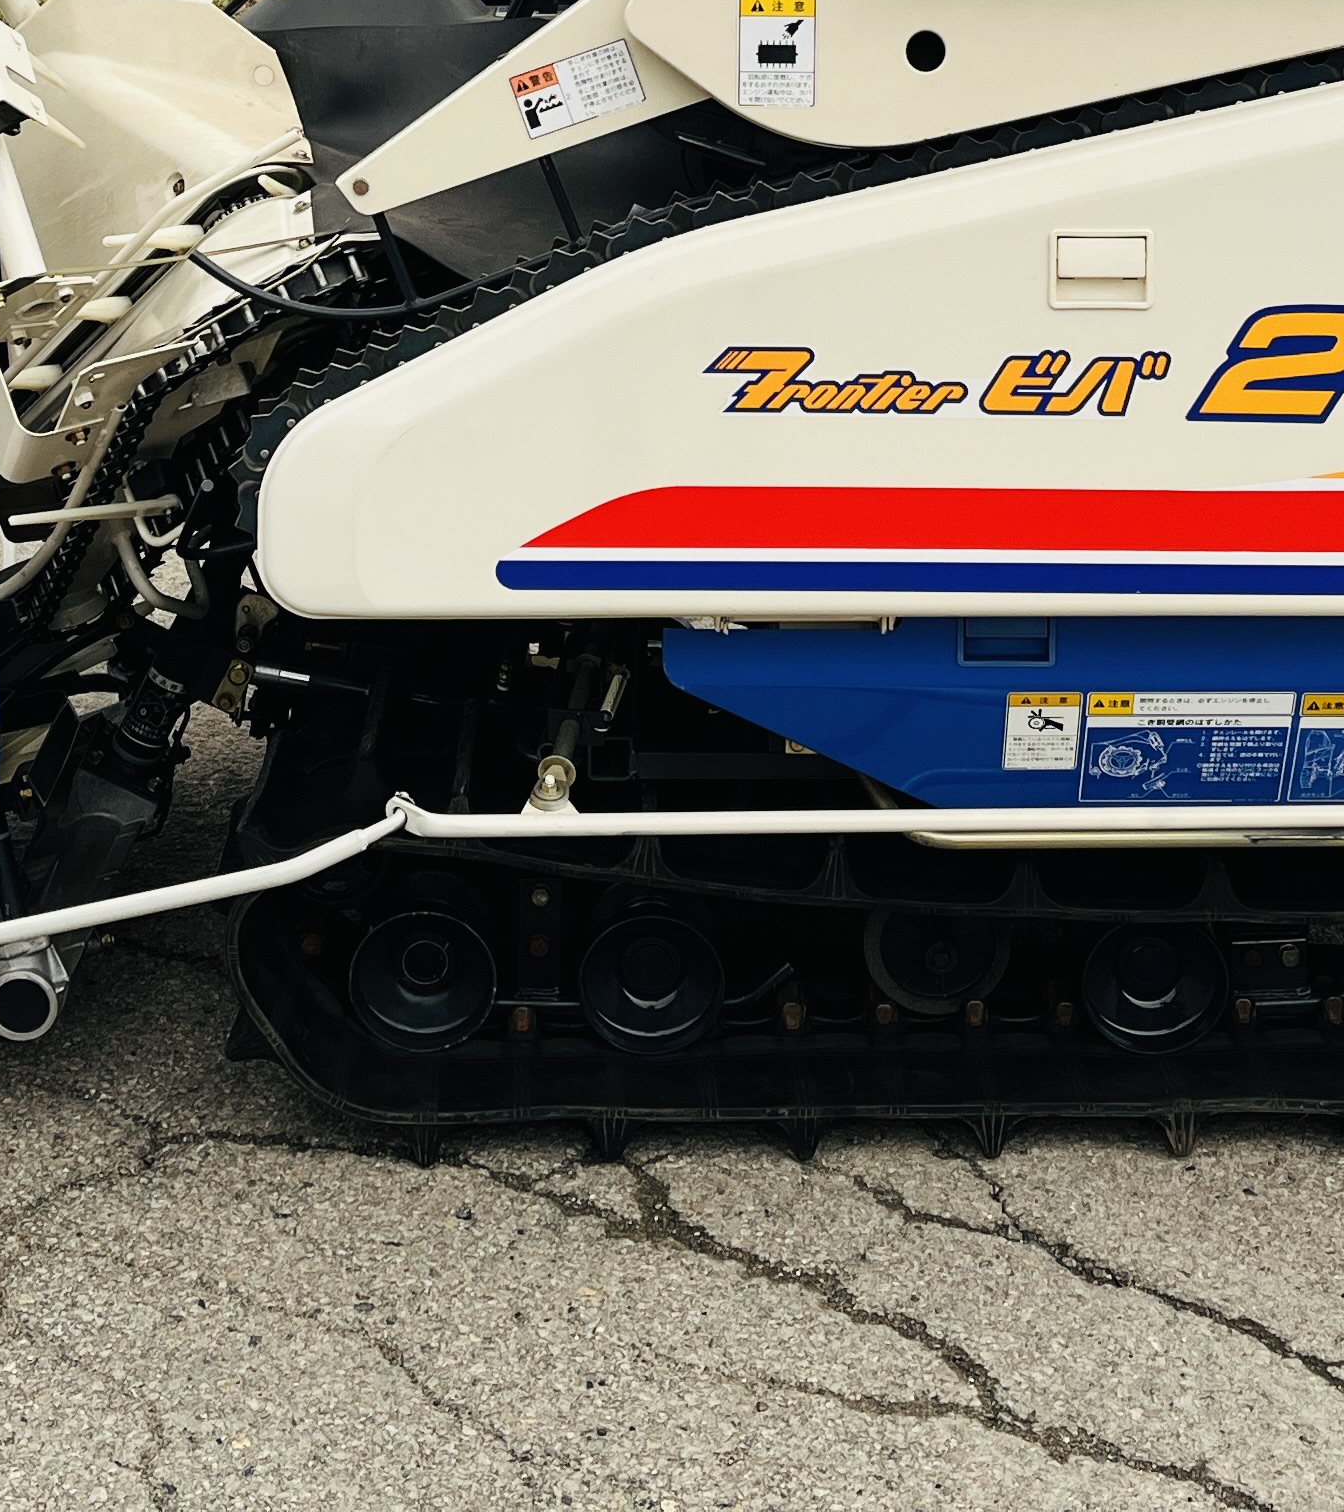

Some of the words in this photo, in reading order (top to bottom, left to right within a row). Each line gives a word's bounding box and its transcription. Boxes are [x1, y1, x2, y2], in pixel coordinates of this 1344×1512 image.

[772, 0, 805, 12] 注意
[529, 71, 554, 88] 警告
[701, 347, 969, 415] Frontier
[979, 350, 1172, 418] ビバ
[1108, 699, 1130, 708] 注意
[1321, 701, 1344, 710] 注意
